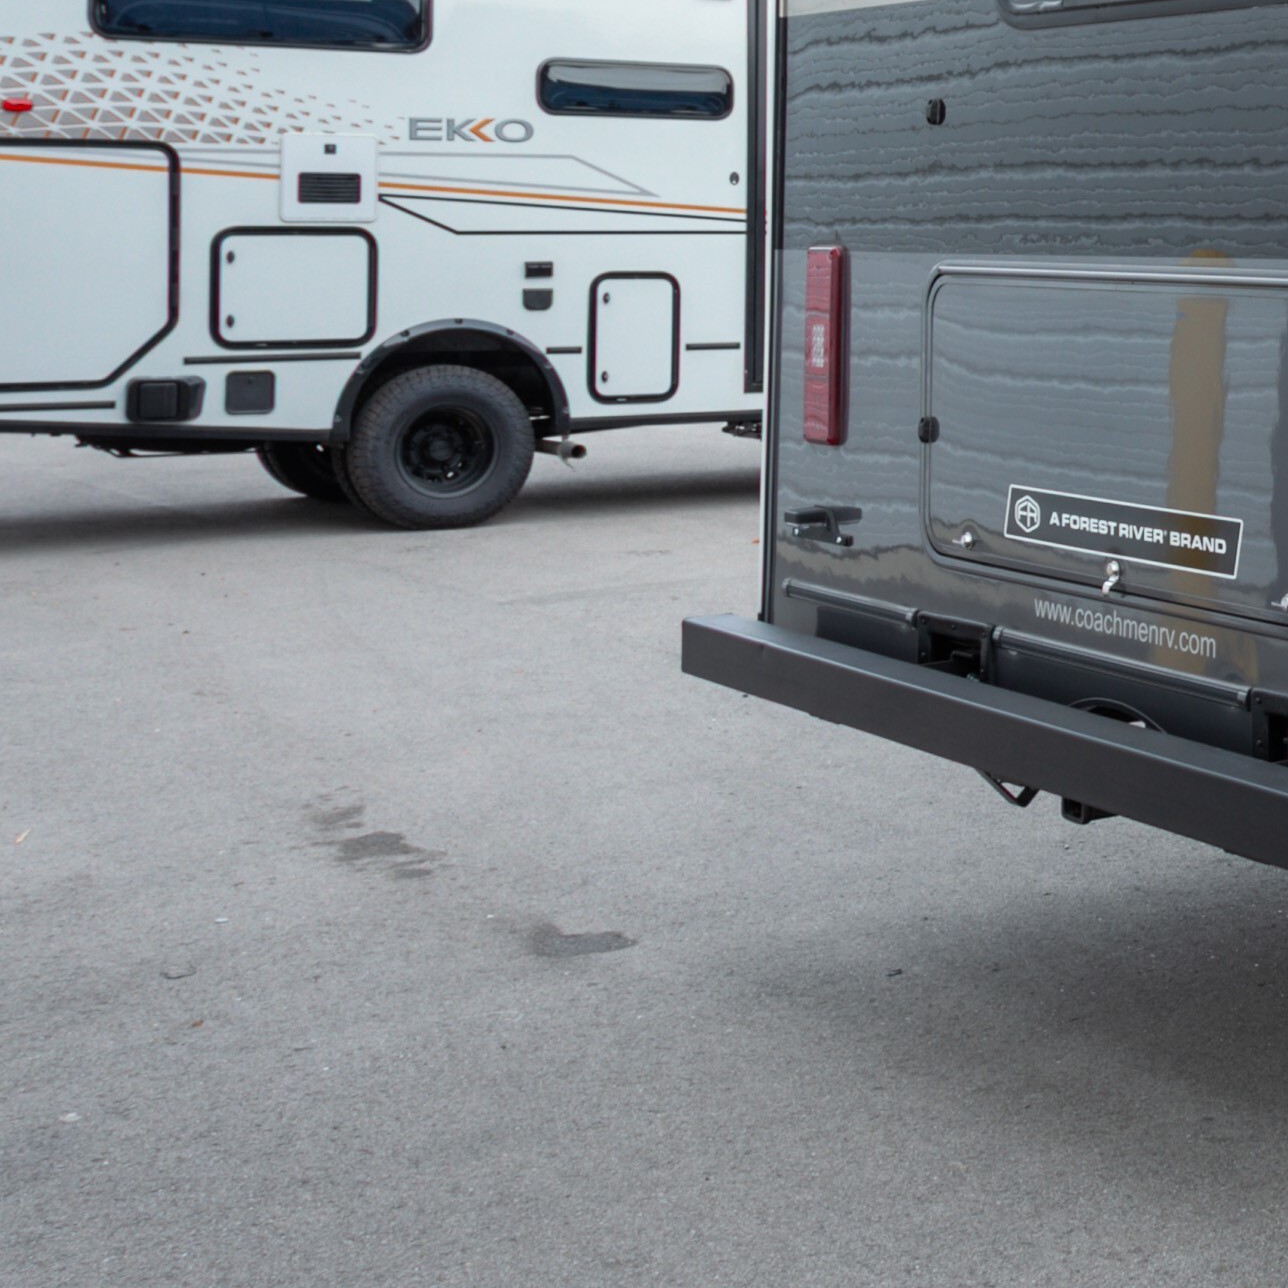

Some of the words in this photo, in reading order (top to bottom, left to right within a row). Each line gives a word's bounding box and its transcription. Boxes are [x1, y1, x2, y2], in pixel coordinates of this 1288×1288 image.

[408, 117, 535, 143] EKKO
[1049, 511, 1061, 526] A
[1061, 513, 1117, 536] FOREST
[1169, 531, 1227, 554] BRAND
[1034, 598, 1217, 659] www.coachmenrv.com
